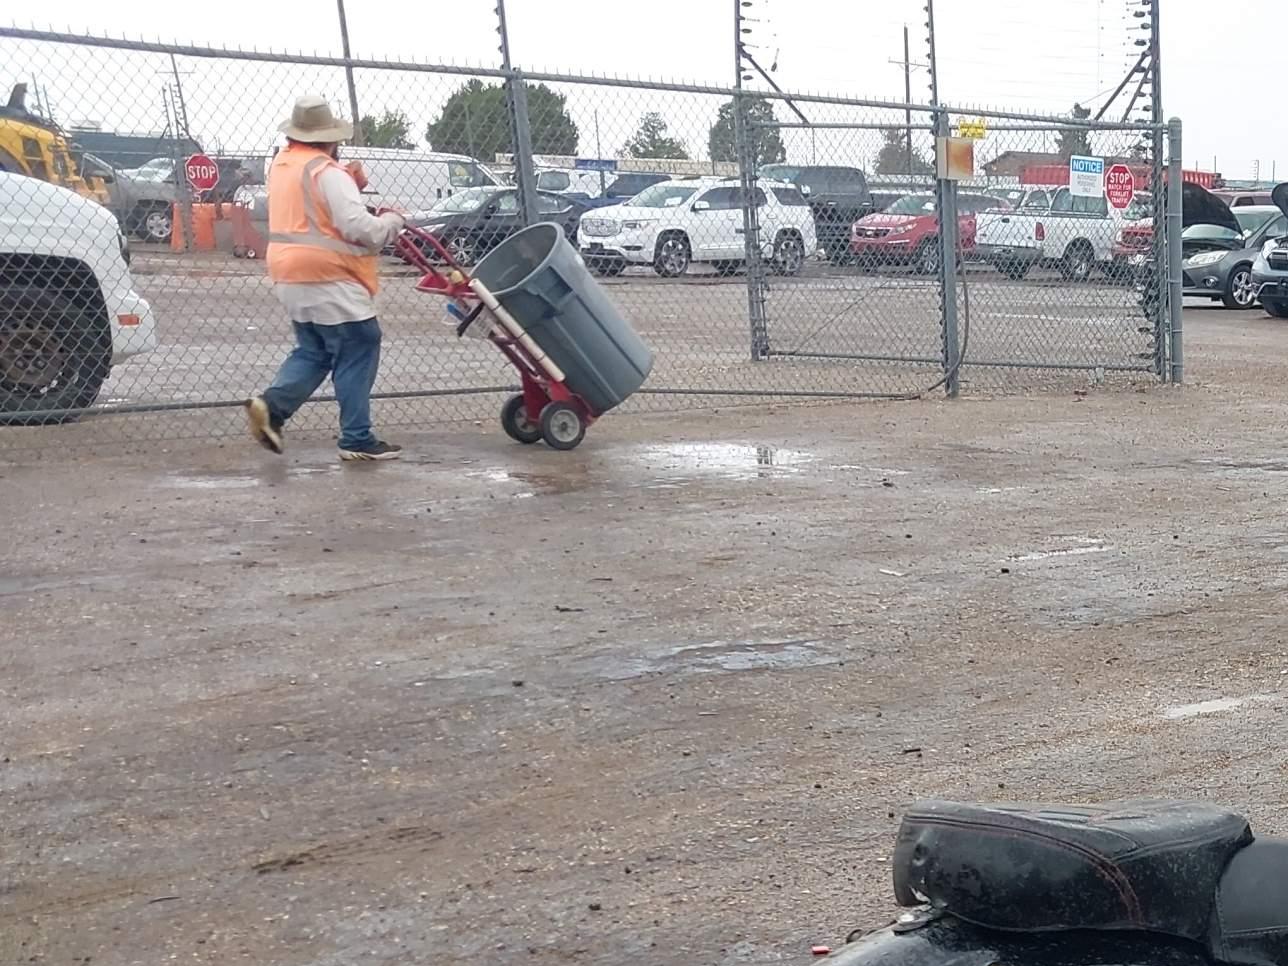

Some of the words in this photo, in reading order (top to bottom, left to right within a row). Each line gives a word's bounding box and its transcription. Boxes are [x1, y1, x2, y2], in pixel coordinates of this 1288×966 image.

[187, 165, 216, 180] STOP
[1073, 159, 1103, 173] NOTICE
[1109, 172, 1130, 185] STOP
